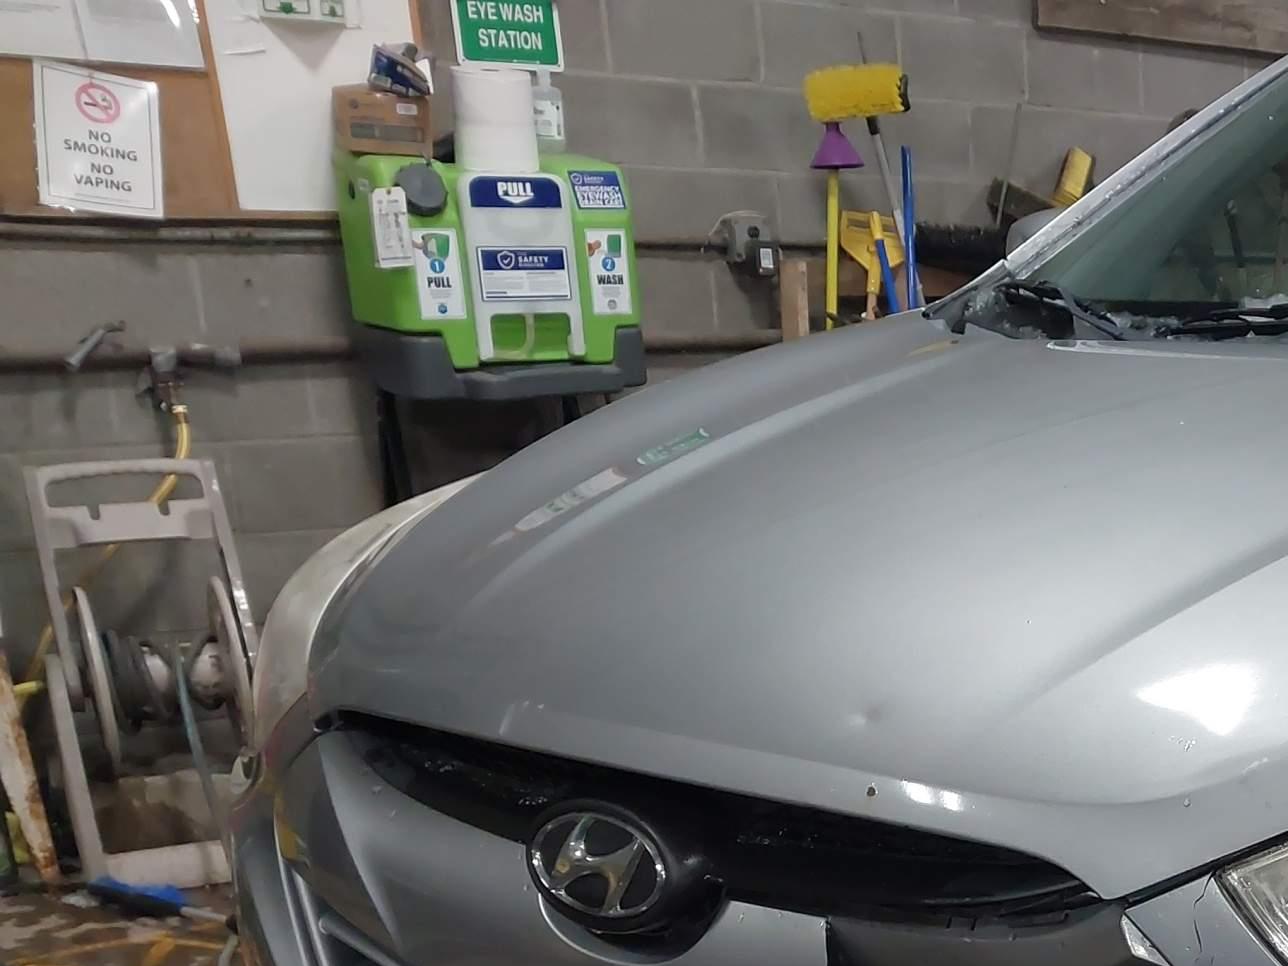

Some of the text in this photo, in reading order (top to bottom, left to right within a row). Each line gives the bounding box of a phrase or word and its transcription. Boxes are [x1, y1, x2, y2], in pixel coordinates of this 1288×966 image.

[466, 0, 544, 23] EYE WASH
[478, 28, 543, 50] STATION
[88, 129, 112, 144] NO
[63, 138, 138, 162] SMOKING
[90, 162, 114, 176] NO
[74, 173, 133, 192] VAPING
[496, 181, 534, 196] PULL
[517, 255, 549, 264] SAFETY
[426, 276, 452, 288] PULL
[597, 274, 624, 285] WASH
